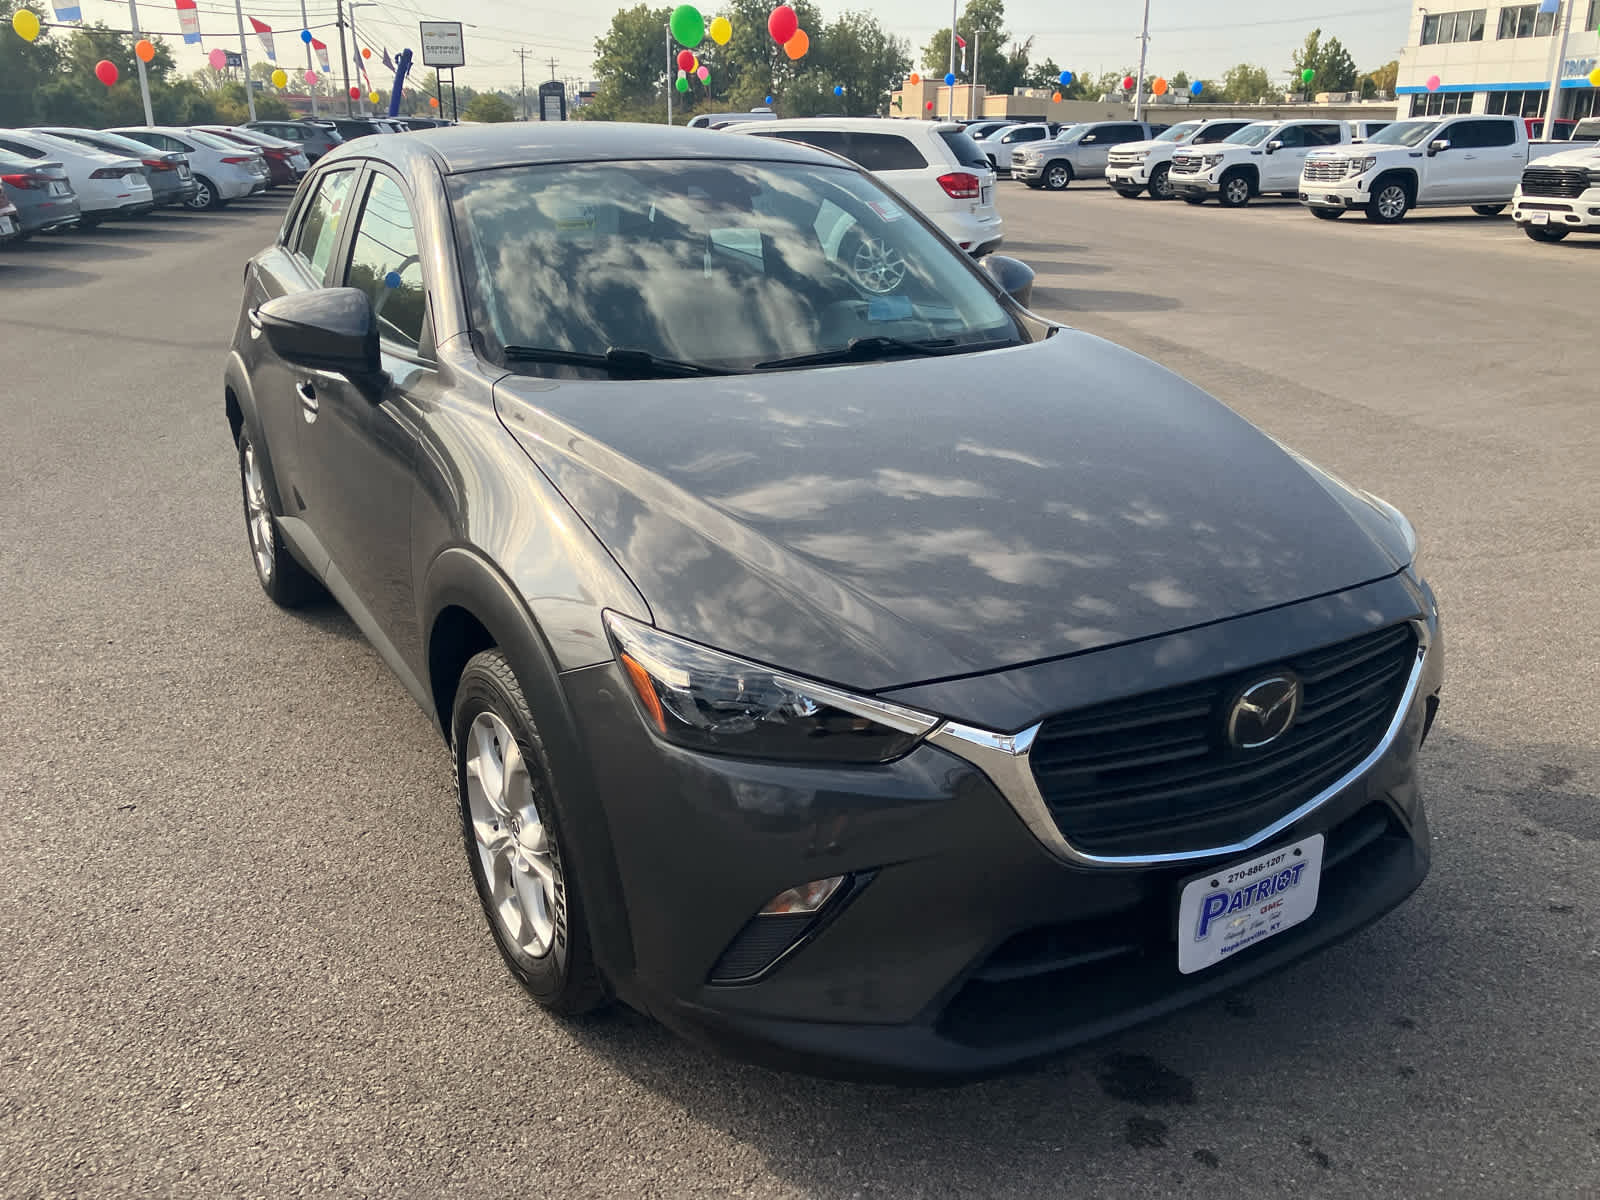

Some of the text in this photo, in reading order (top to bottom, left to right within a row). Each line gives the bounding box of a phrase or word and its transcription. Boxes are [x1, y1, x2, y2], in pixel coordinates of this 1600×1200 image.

[1195, 861, 1309, 941] PATRIOT
[1260, 898, 1284, 915] GMC
[1270, 922, 1281, 931] KY
